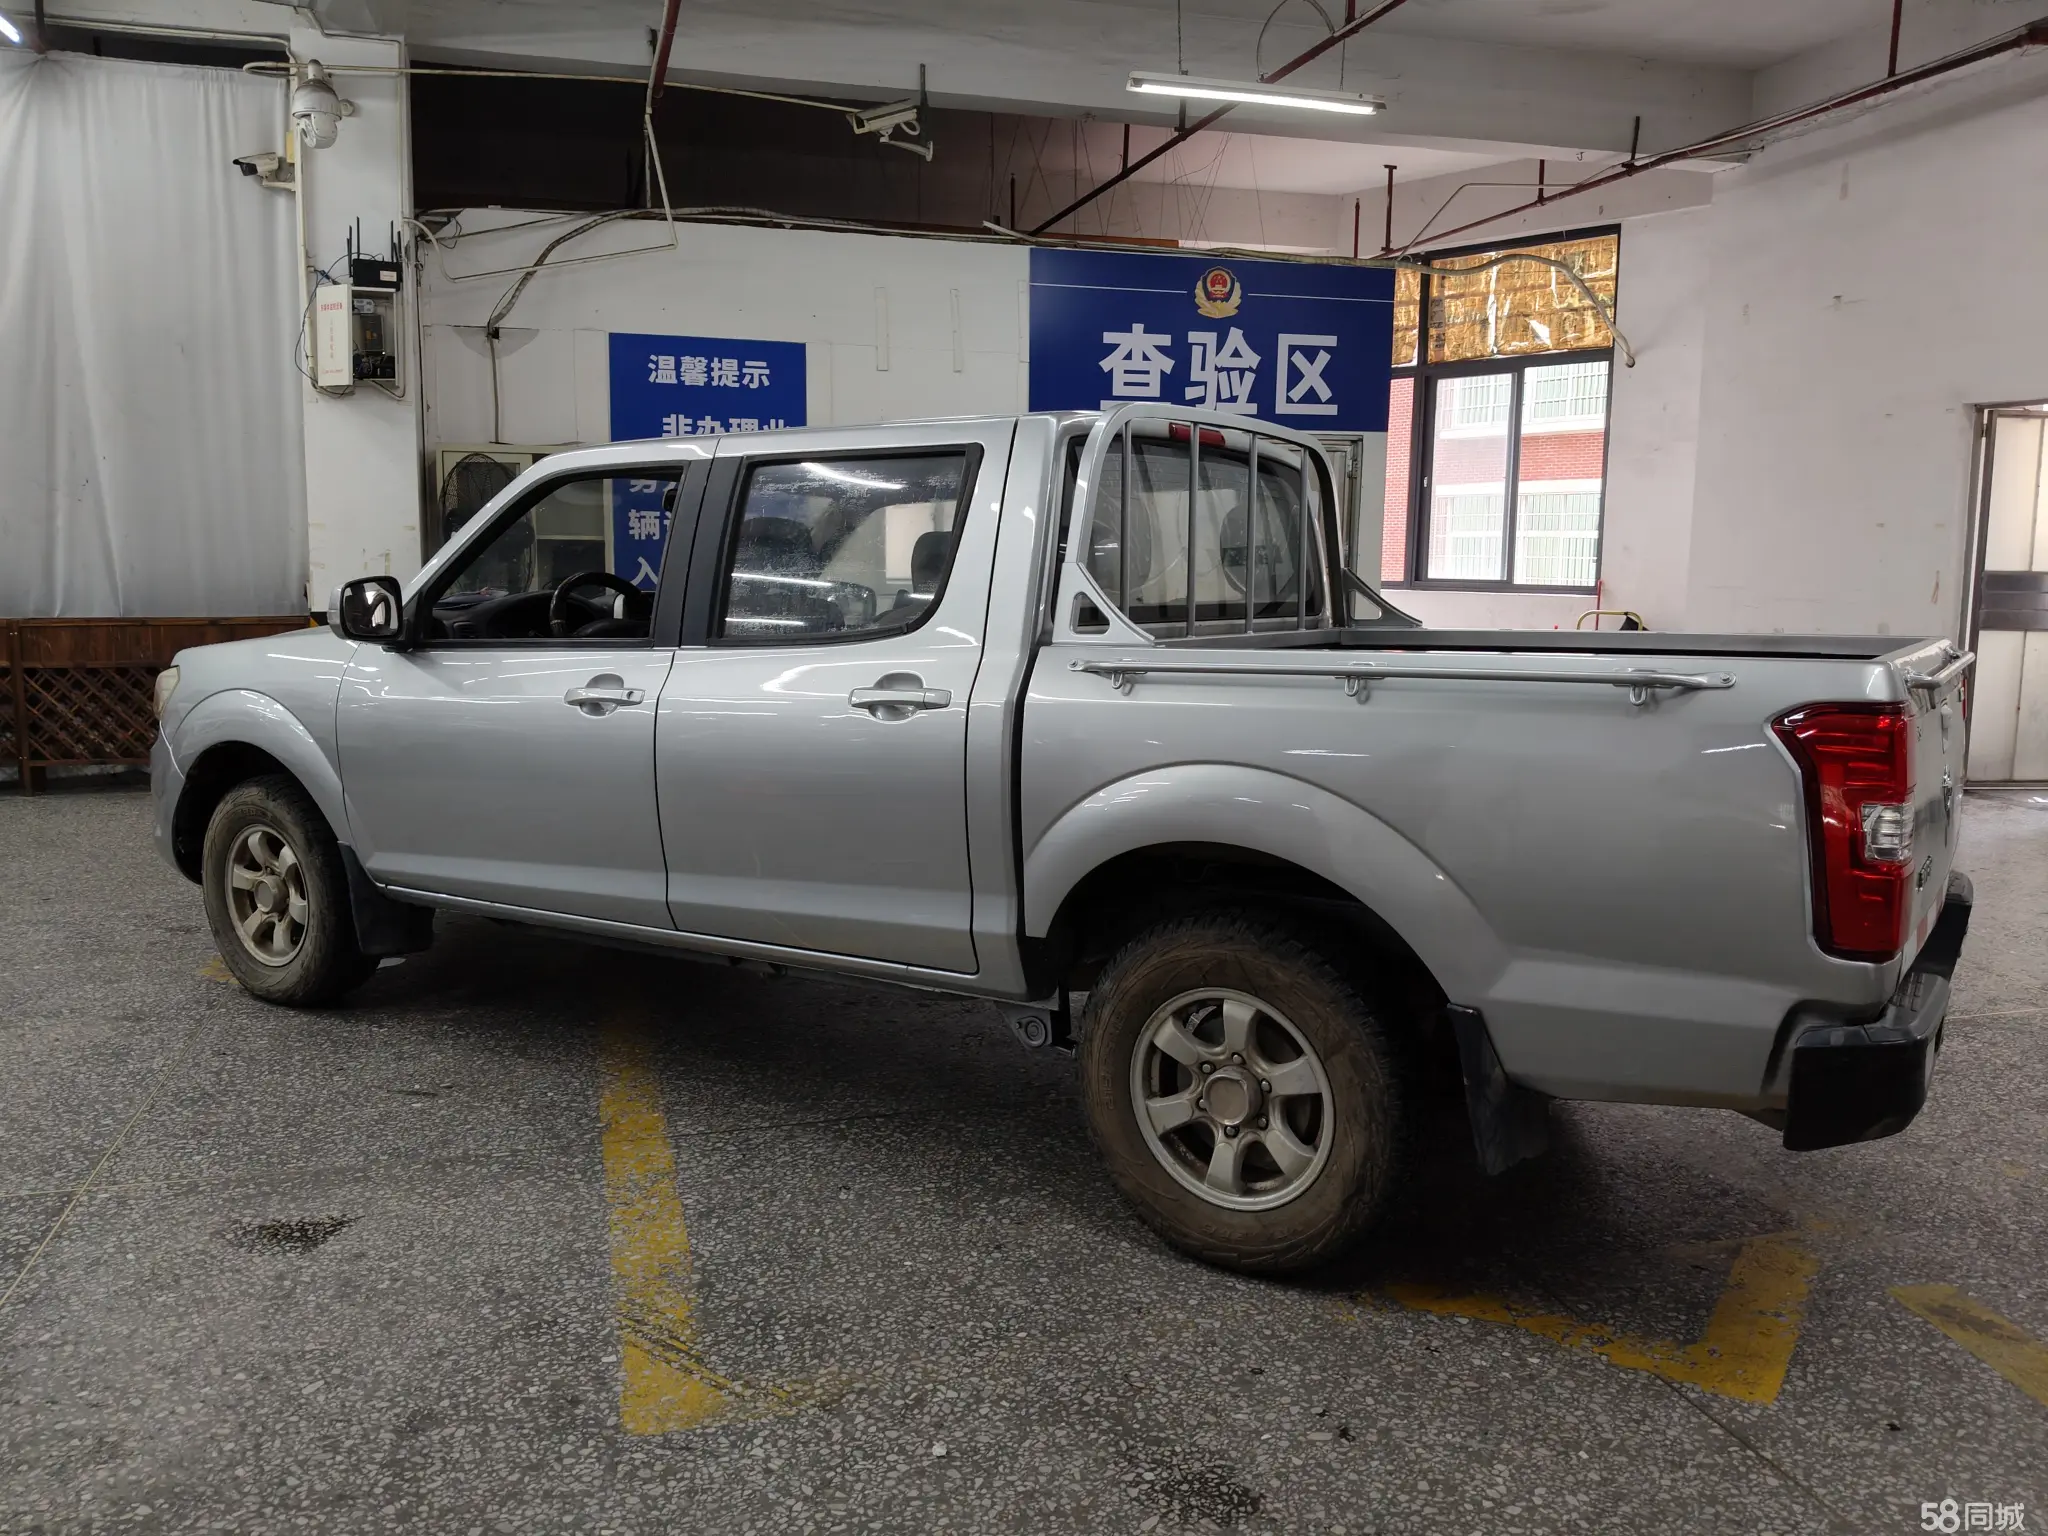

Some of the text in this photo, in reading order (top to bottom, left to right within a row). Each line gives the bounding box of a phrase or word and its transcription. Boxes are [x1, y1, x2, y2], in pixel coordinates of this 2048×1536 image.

[648, 354, 770, 389] 温馨提示
[1099, 323, 1338, 415] 查验区
[628, 508, 673, 541] 辆
